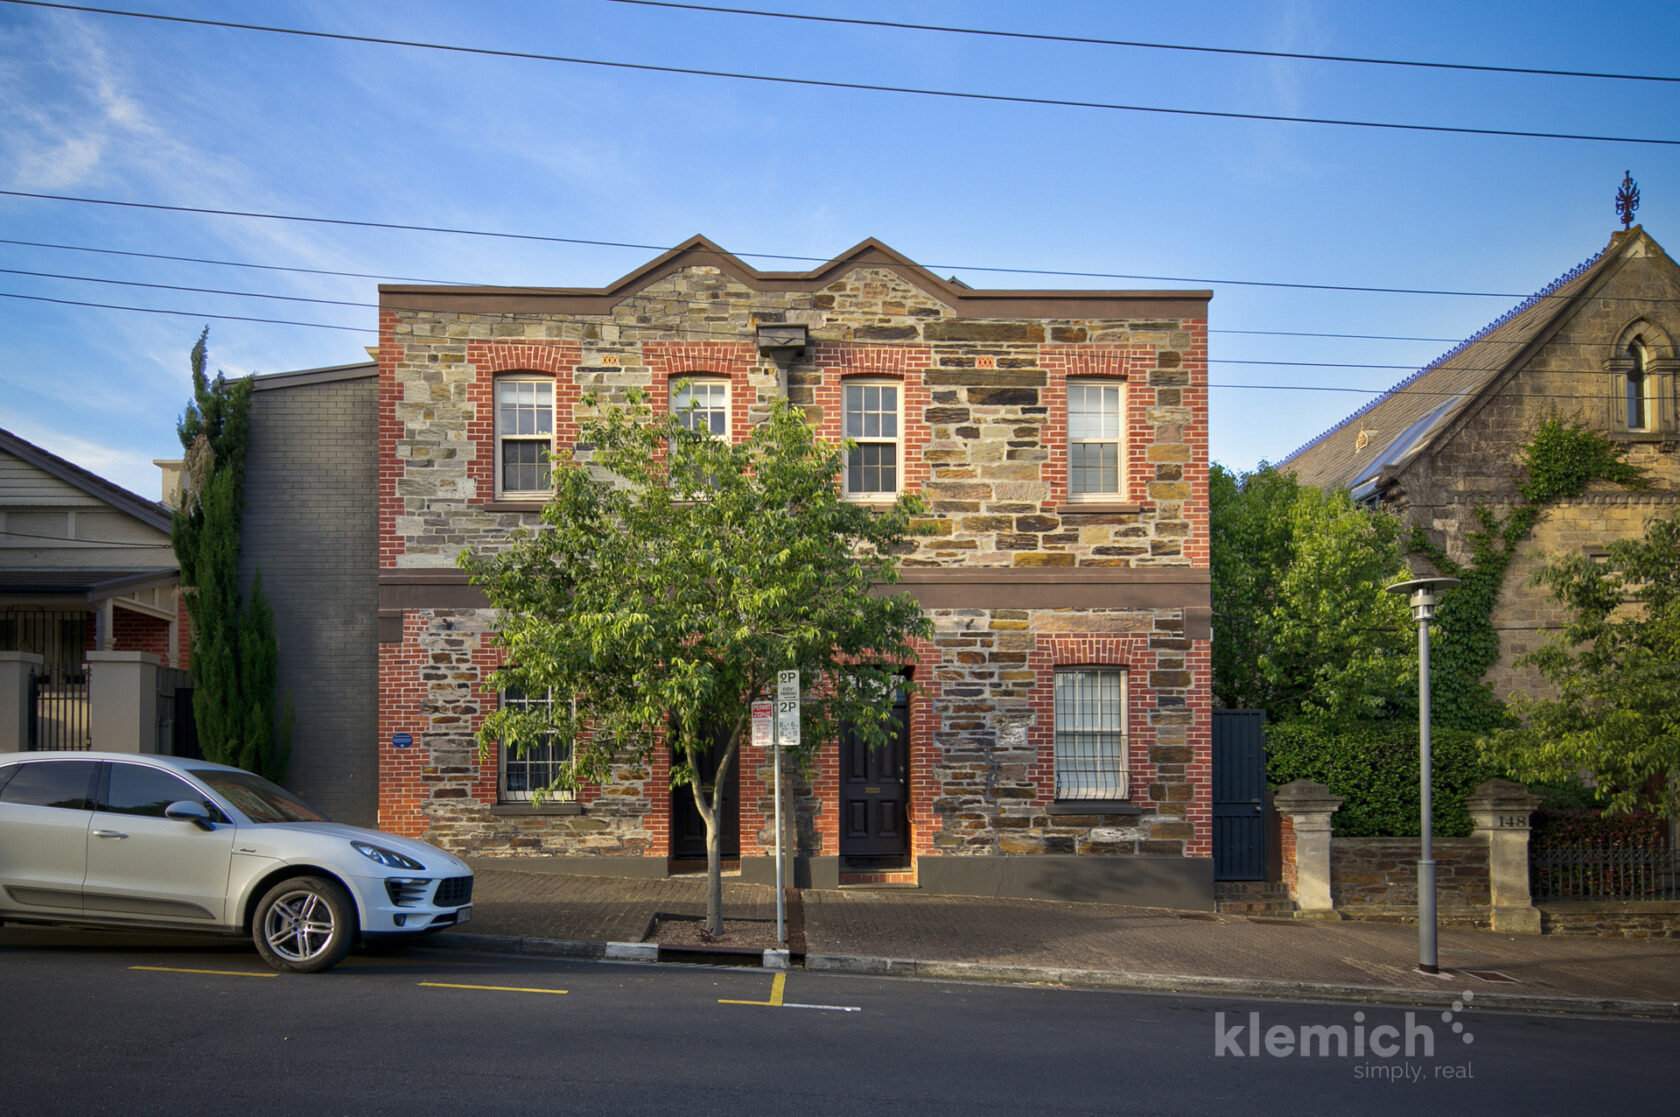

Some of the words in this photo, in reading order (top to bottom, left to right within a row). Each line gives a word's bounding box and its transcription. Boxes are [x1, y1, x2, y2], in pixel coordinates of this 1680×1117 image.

[780, 672, 796, 683] 2P
[780, 702, 796, 712] 2P
[1499, 815, 1526, 827] 148
